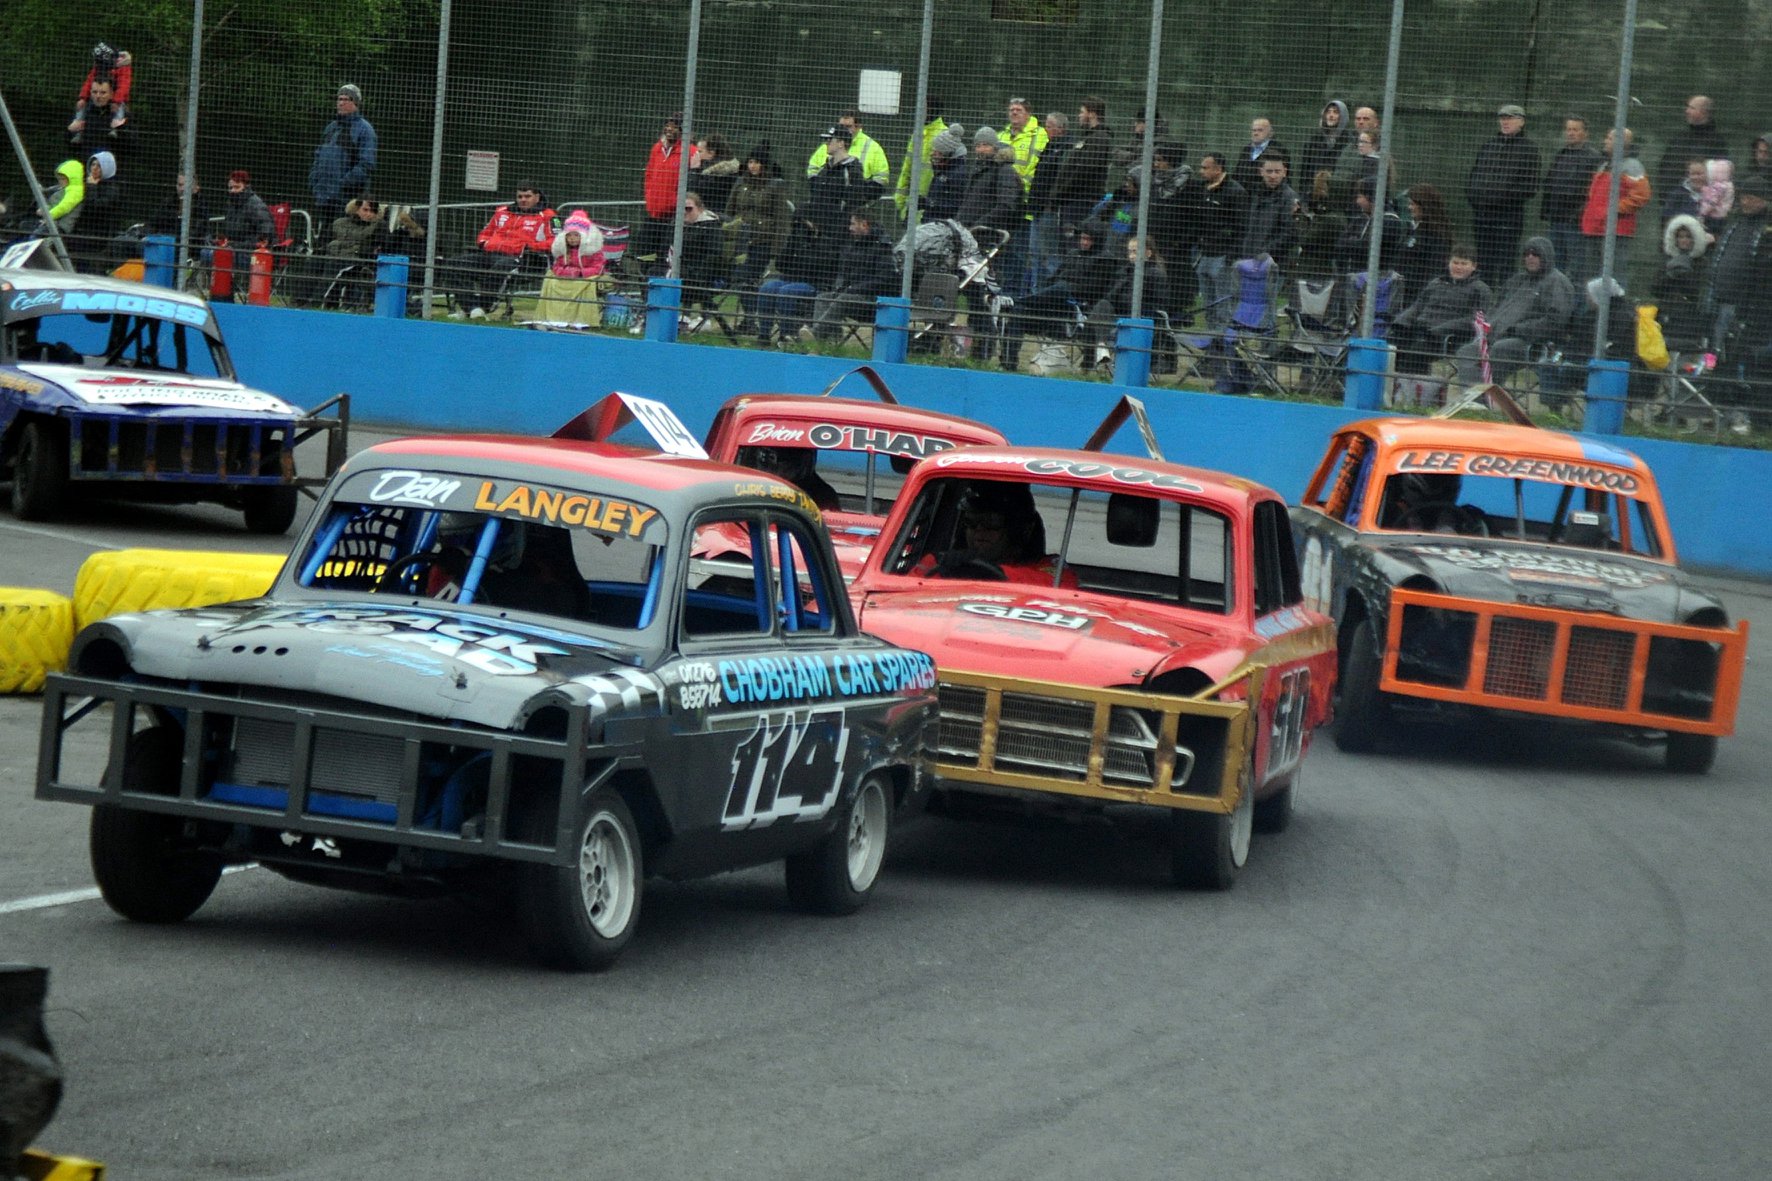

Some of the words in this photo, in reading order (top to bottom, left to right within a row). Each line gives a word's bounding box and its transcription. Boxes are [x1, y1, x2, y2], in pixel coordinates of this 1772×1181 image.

[61, 293, 208, 326] MOSS
[633, 402, 696, 448] 114
[748, 424, 804, 443] Brian
[1023, 458, 1205, 494] COOL
[1398, 450, 1464, 472] LEE
[1467, 453, 1641, 497] GREENWOOD
[369, 471, 461, 507] Dan
[473, 481, 657, 538] LANGLEY
[718, 655, 832, 704] CHOBHAM
[833, 654, 881, 697] CAR
[875, 652, 937, 692] SPARES
[720, 703, 850, 832] 114
